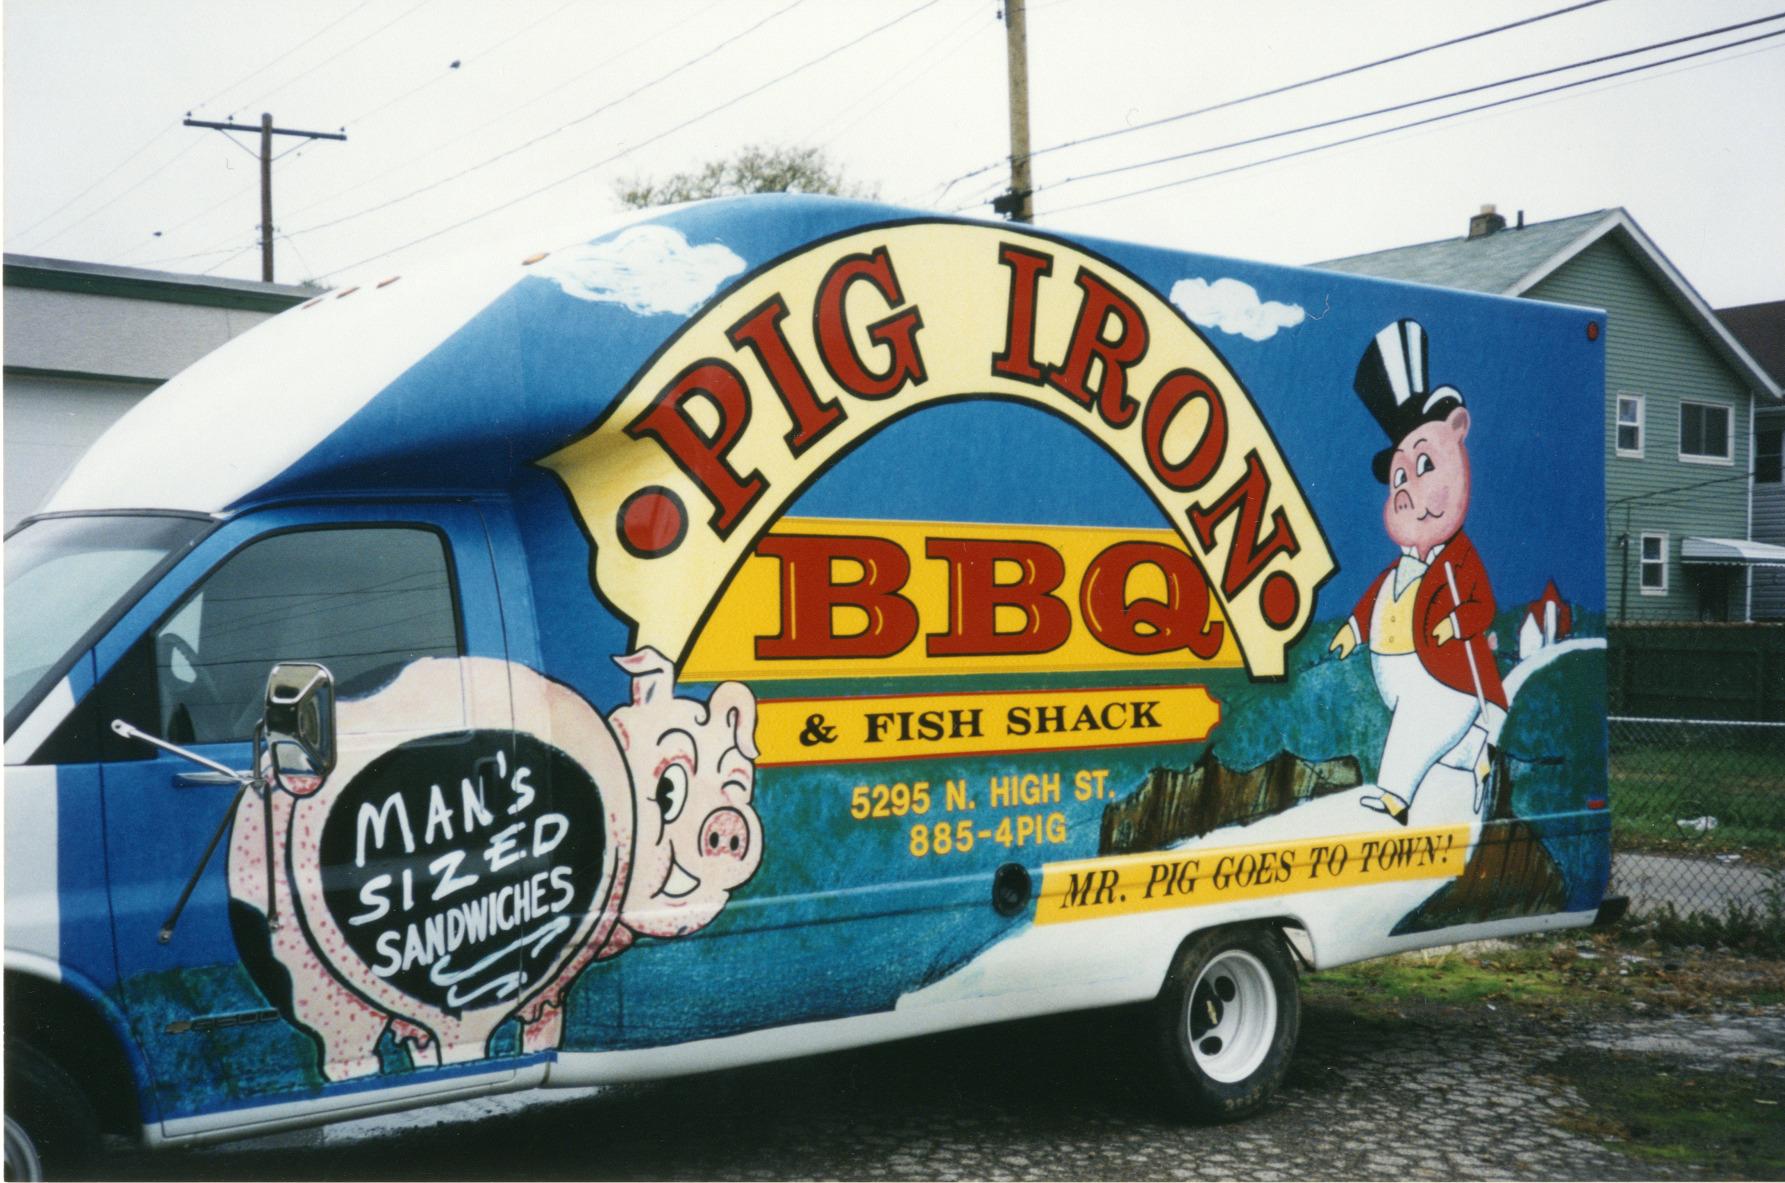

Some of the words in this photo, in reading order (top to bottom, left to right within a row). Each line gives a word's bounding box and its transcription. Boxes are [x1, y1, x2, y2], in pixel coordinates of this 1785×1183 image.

[624, 245, 927, 541] PIG
[991, 241, 1300, 603] IRON
[754, 534, 1225, 660] BBQ
[798, 713, 839, 747] &
[863, 708, 985, 744] FISH
[1006, 701, 1163, 736] SHACK
[355, 750, 536, 868] MAN'S
[850, 782, 931, 820] 5295
[945, 780, 976, 812] N.
[989, 772, 1061, 808] HIGH
[1074, 769, 1116, 802] ST.
[909, 812, 1067, 858] 885-4PIG
[348, 813, 570, 926] SIZED
[371, 866, 575, 978] SANDWICHES
[1060, 868, 1127, 909] MR.
[1143, 860, 1201, 899] PIG
[1212, 850, 1293, 890] GOES
[1308, 843, 1348, 879] TO
[1358, 833, 1455, 874] TOWN!
